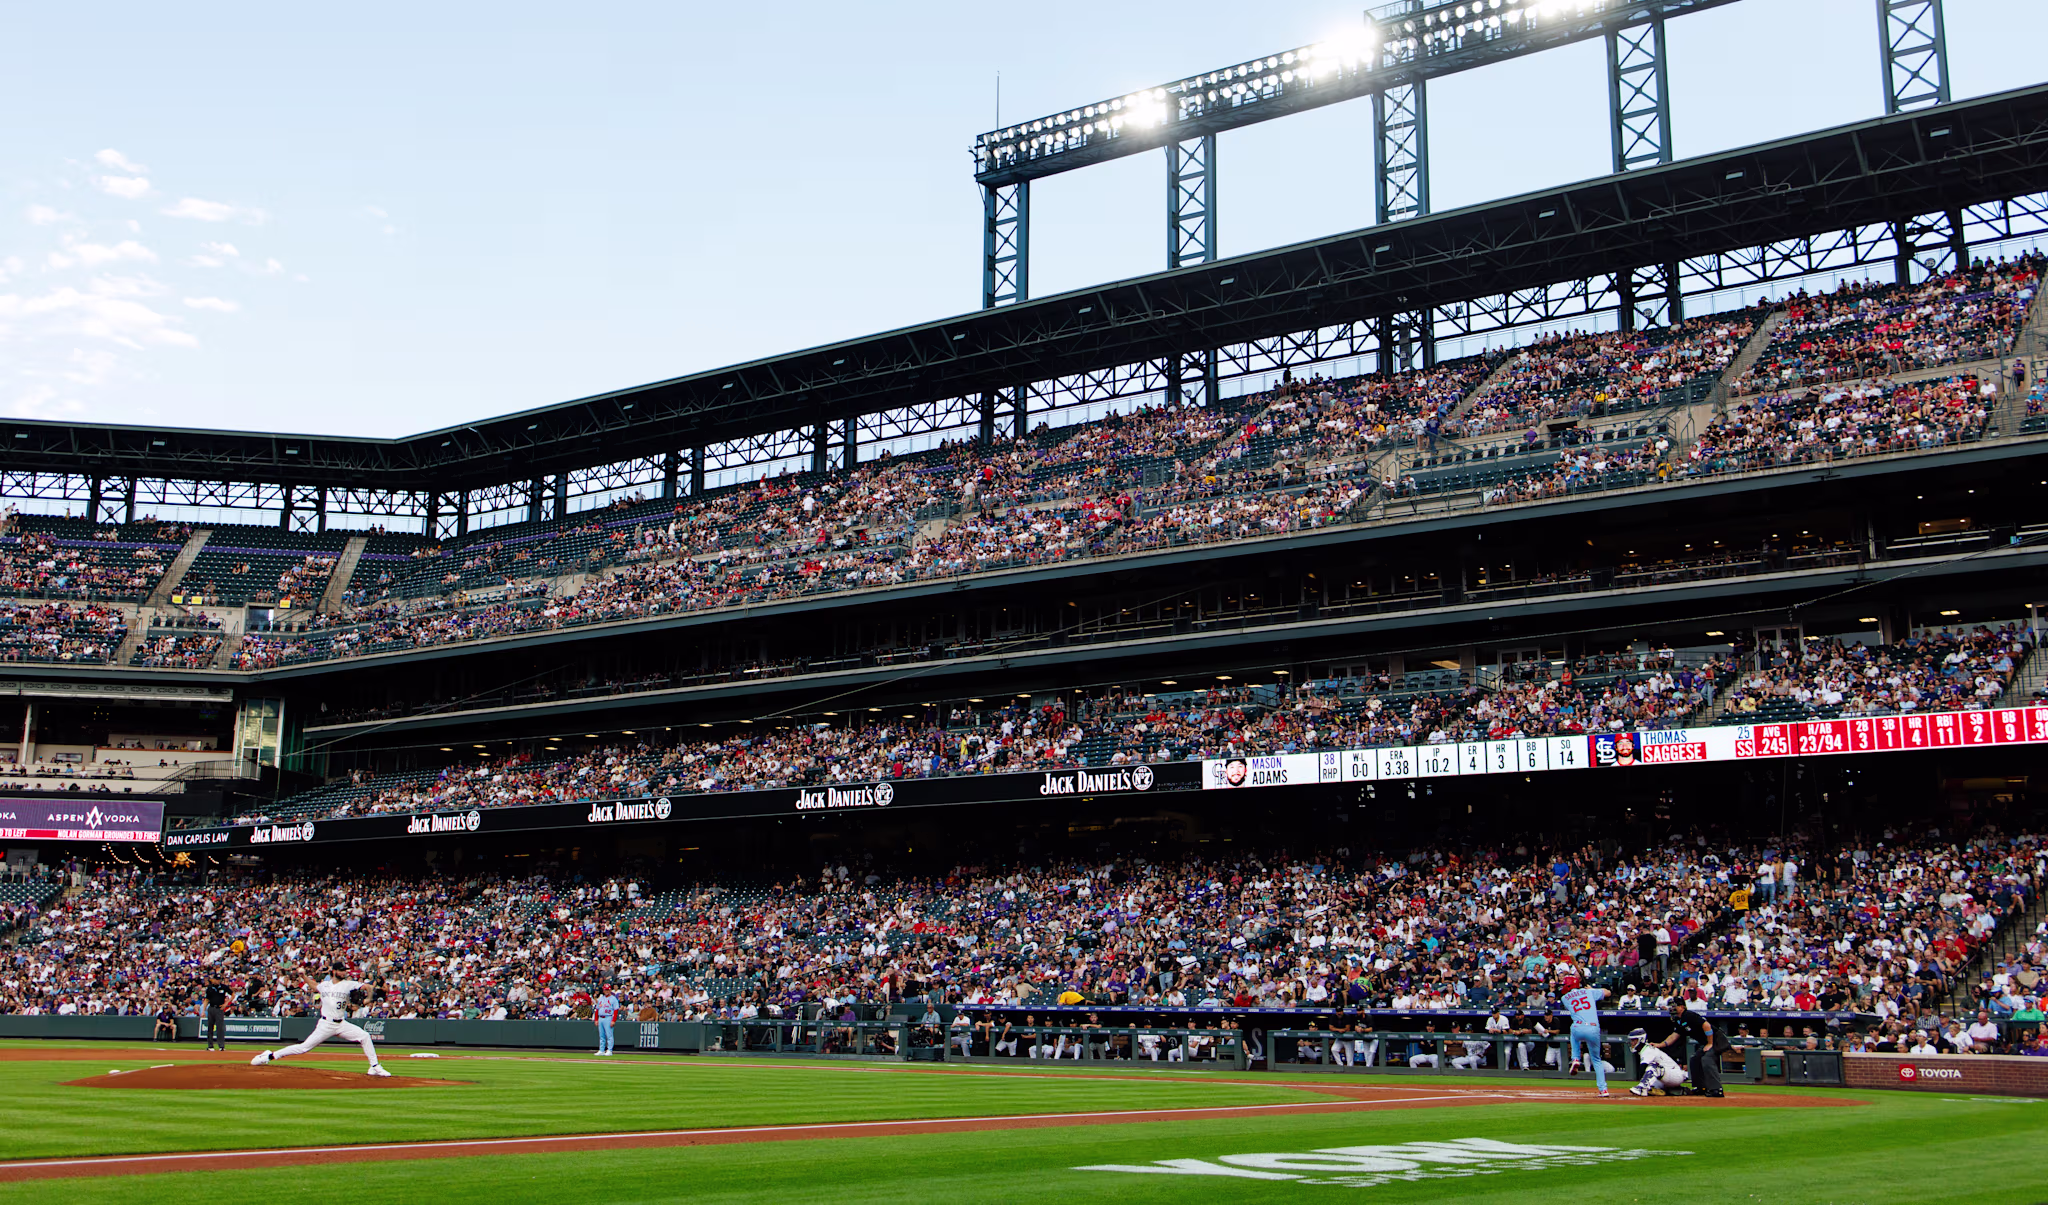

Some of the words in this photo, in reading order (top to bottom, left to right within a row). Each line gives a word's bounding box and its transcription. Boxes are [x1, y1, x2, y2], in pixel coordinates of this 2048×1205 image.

[1908, 717, 1922, 729] HR
[1936, 715, 1953, 727] RBI
[1969, 713, 1984, 725] SB
[2001, 711, 2016, 723] BB
[1807, 723, 1832, 735] H/AB
[1856, 721, 1868, 732] 2B
[1882, 719, 1895, 730] 3B
[1643, 730, 1687, 745] THOMAS
[1737, 726, 1750, 739] 25
[1762, 726, 1781, 737] AVG
[1912, 729, 1921, 746] 4
[1937, 728, 1954, 744] 11
[1973, 725, 1983, 742] 2
[2004, 723, 2015, 741] 9
[1560, 739, 1571, 749] SO
[1799, 734, 1843, 753] 23/94
[1859, 732, 1868, 749] 3
[1886, 731, 1893, 747] 1
[1433, 748, 1440, 757] IP
[1467, 746, 1477, 755] ER
[1495, 744, 1506, 753] HR
[1526, 742, 1536, 751] BB
[1644, 743, 1702, 762] SAGGESE
[1737, 740, 1753, 757] SS
[1758, 737, 1787, 755] .245
[1324, 753, 1335, 765] 38
[1352, 752, 1365, 762] W-L
[1389, 750, 1404, 760] ERA
[1528, 752, 1536, 768] 6
[1559, 750, 1574, 766] 14
[1252, 757, 1282, 770] MASON
[1385, 760, 1409, 776] 3.38
[1425, 757, 1450, 773] 10.2
[1469, 756, 1476, 771] 4
[1498, 754, 1505, 770] 3
[1252, 769, 1288, 785] ADAMS
[1322, 768, 1338, 780] RHP
[1352, 763, 1368, 778] 0-0
[1040, 773, 1075, 795] JACK
[1077, 769, 1132, 793] DANIEL'S
[795, 789, 826, 810] JACK
[827, 785, 874, 808] DANIEL'S
[588, 803, 614, 822] JACK
[615, 800, 655, 820] DANIEL'S
[47, 813, 84, 822] ASPEN
[104, 814, 140, 823] VODKA
[407, 815, 430, 834] JACK
[431, 812, 466, 832] DANIEL'S
[5, 829, 12, 837] TO
[13, 829, 27, 838] LEFT
[58, 829, 78, 839] NOLAN
[78, 830, 103, 839] GORMAN
[103, 830, 135, 840] GROUNDED
[135, 831, 143, 840] TO
[144, 831, 160, 840] FIRST
[167, 835, 183, 846] DAN
[184, 833, 211, 845] CAPLIS
[211, 832, 230, 843] LAW
[250, 826, 271, 844] JACK
[336, 1001, 347, 1010] 38
[1571, 996, 1591, 1013] 25
[225, 1024, 248, 1032] WINNING
[640, 1023, 659, 1035] COORS
[639, 1035, 659, 1048] FIELD
[1919, 1068, 1962, 1078] TOYOTA
[1069, 1137, 1620, 1181] YORK
